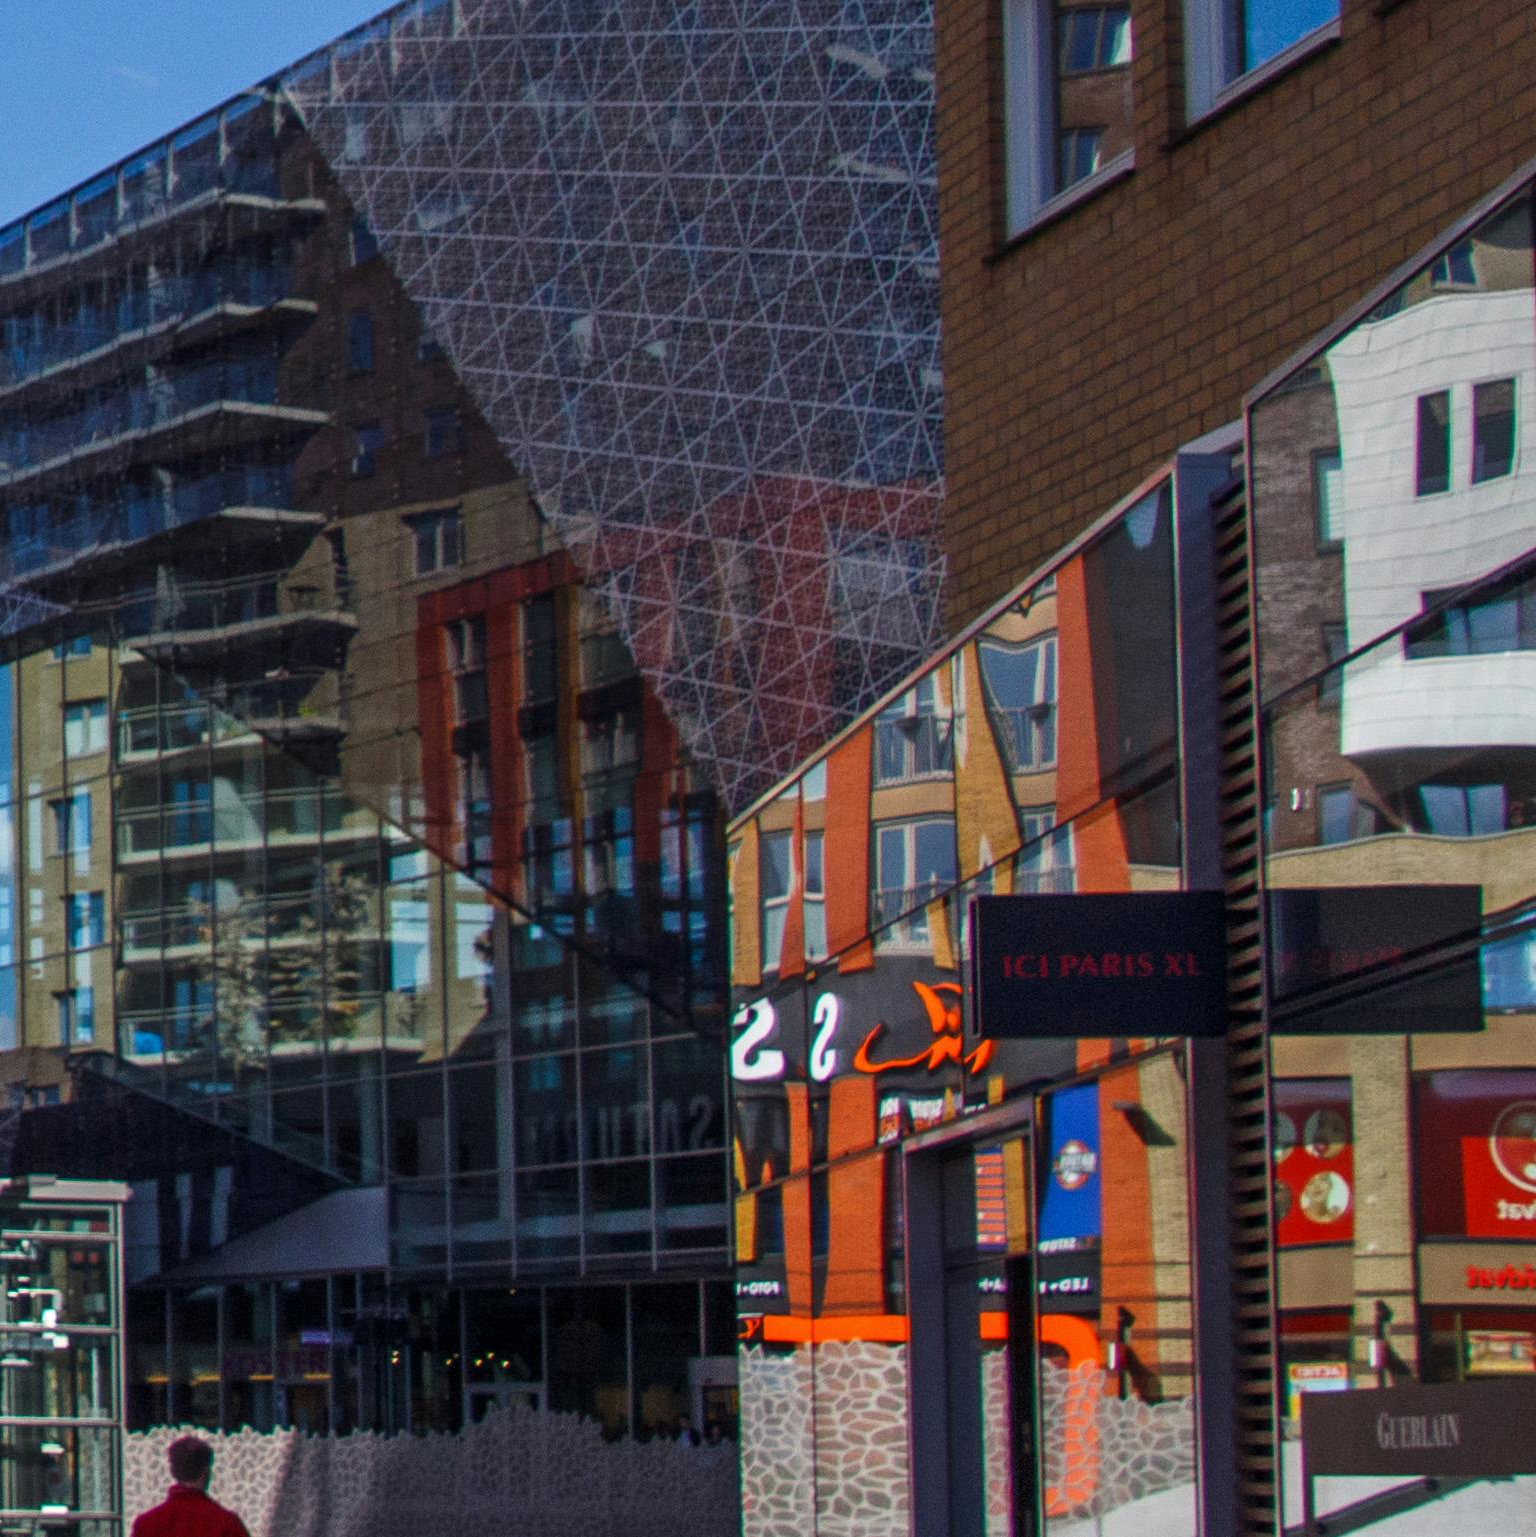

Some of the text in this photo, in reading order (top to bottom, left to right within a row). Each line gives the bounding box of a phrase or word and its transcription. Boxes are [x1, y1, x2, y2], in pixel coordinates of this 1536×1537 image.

[1002, 951, 1199, 978] ICI PARIS XL
[1377, 1412, 1461, 1449] GUERLAIN
